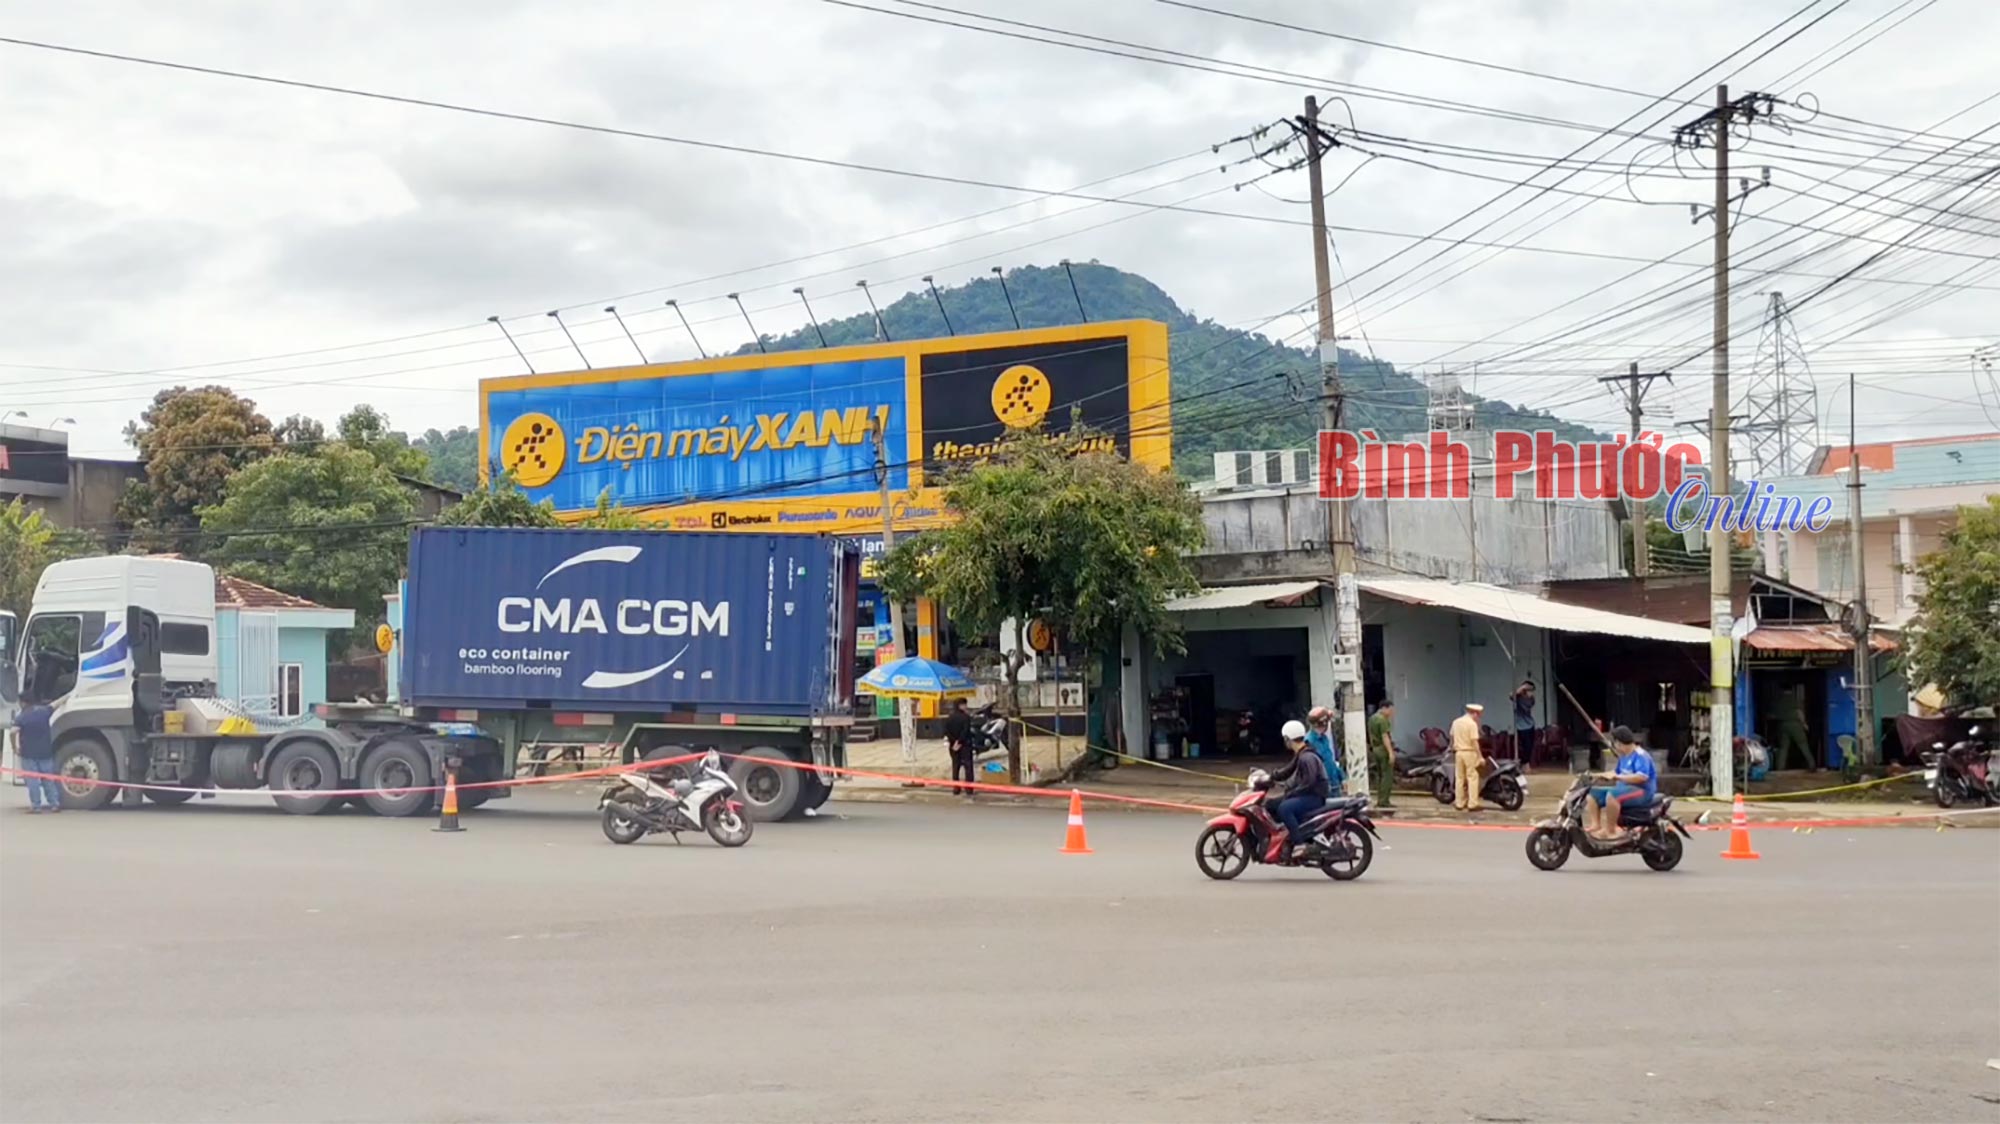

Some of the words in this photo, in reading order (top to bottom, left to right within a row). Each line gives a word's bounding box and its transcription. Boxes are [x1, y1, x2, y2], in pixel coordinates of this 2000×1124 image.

[575, 423, 662, 470] Điện
[498, 597, 608, 634] CMA
[617, 599, 729, 636] CGM
[459, 648, 487, 660] eco
[492, 647, 570, 661] container
[464, 662, 515, 675] bamboo
[516, 663, 562, 678] flooring
